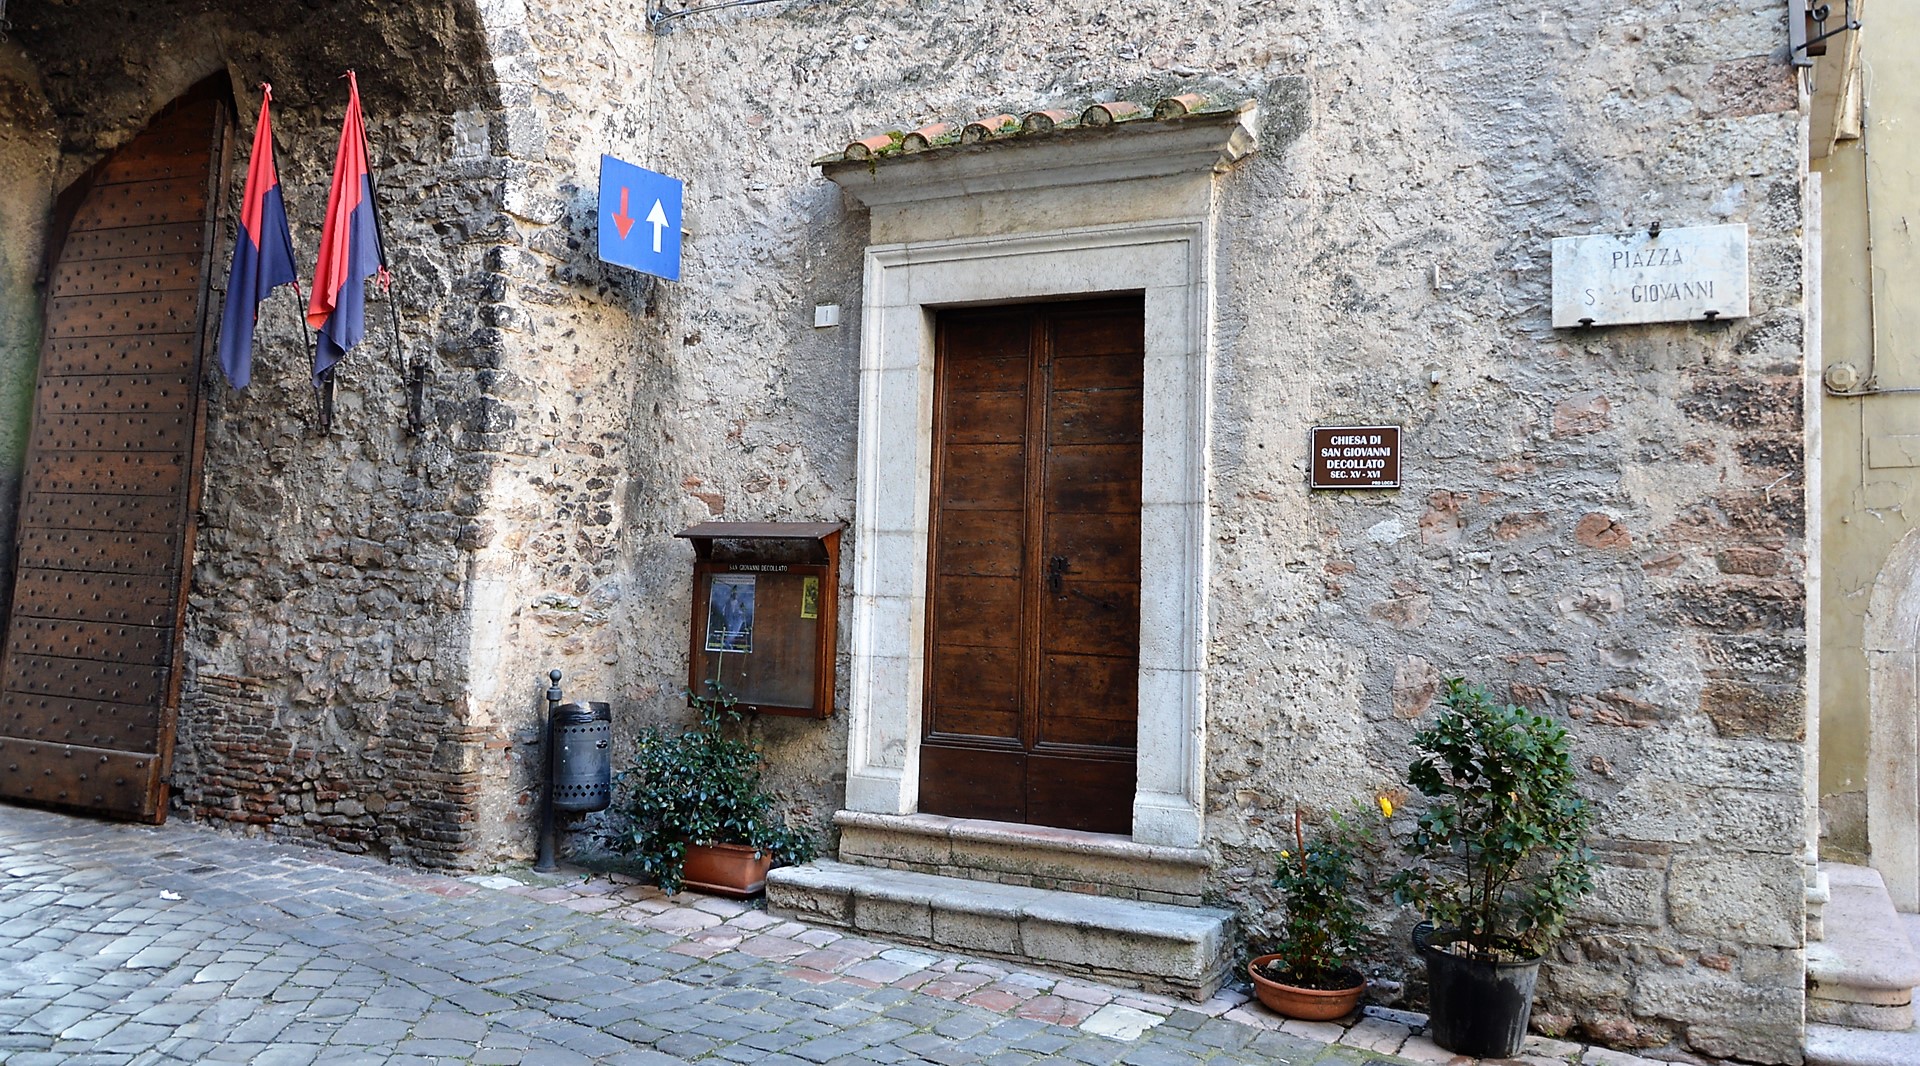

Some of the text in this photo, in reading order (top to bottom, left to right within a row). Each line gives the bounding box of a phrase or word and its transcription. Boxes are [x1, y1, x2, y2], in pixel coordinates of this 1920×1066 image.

[1612, 248, 1683, 269] PIAZZA
[1631, 280, 1713, 304] GIOVANNI
[1330, 435, 1382, 446] CHIESA DI
[1321, 447, 1391, 457] SAN GIOVANNI
[1326, 459, 1386, 469] DECOLLATO
[1330, 470, 1349, 479] SEC.
[1350, 470, 1361, 478] XV
[1367, 470, 1381, 478] XVI
[761, 564, 788, 572] DECOLLATO
